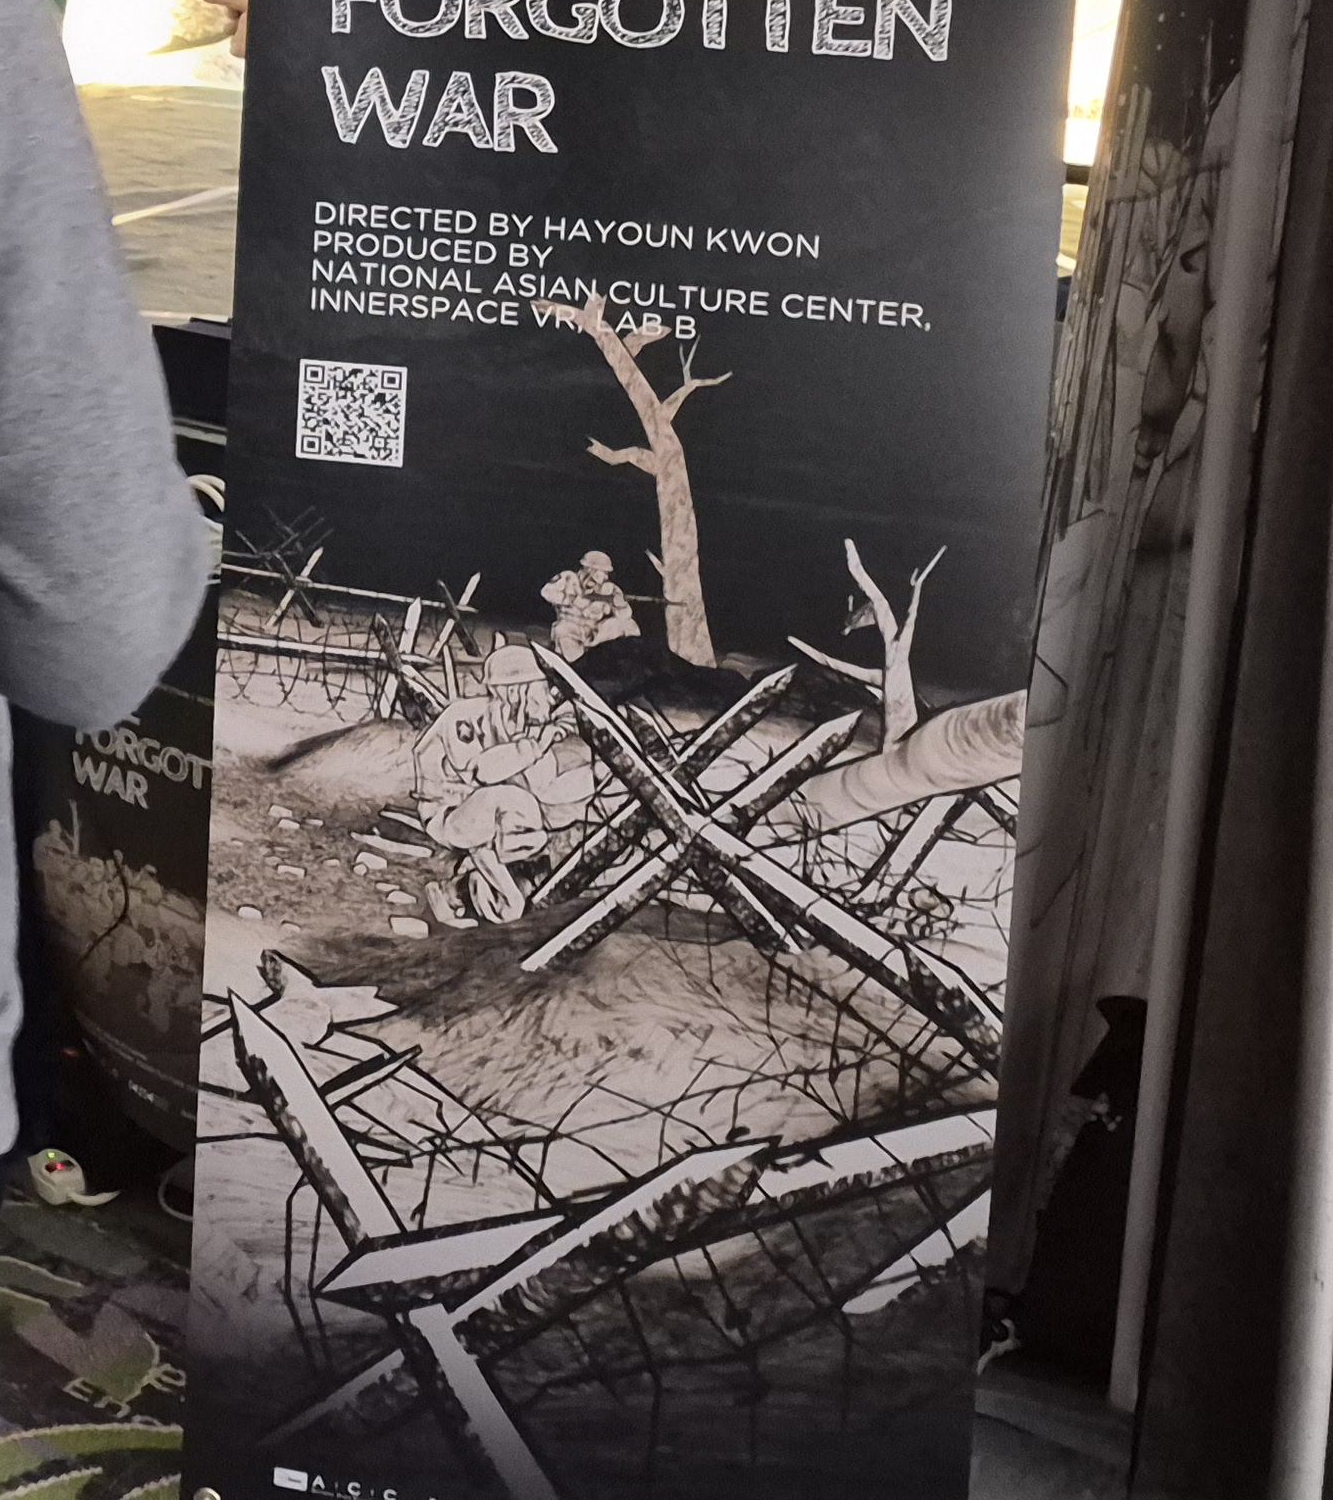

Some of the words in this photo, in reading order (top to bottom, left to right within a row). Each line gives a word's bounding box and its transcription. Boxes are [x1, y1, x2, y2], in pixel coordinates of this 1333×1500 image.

[322, 66, 558, 153] WAR
[313, 230, 498, 265] PRODUCED
[509, 243, 553, 268] BY
[314, 201, 477, 235] DIRECTED
[489, 212, 534, 238] BY
[544, 215, 694, 250] HAYOUN
[706, 227, 820, 259] KWON
[310, 287, 520, 326] INNERSPACE
[531, 303, 583, 334] VR,
[596, 309, 664, 336] LAB
[674, 315, 697, 340] B
[311, 258, 483, 294] NATIONAL
[493, 271, 597, 302] ASIAN
[608, 280, 770, 316] CULTURE
[781, 293, 931, 332] CENTER,
[72, 751, 150, 809] WAR
[75, 728, 213, 790] ORGOT
